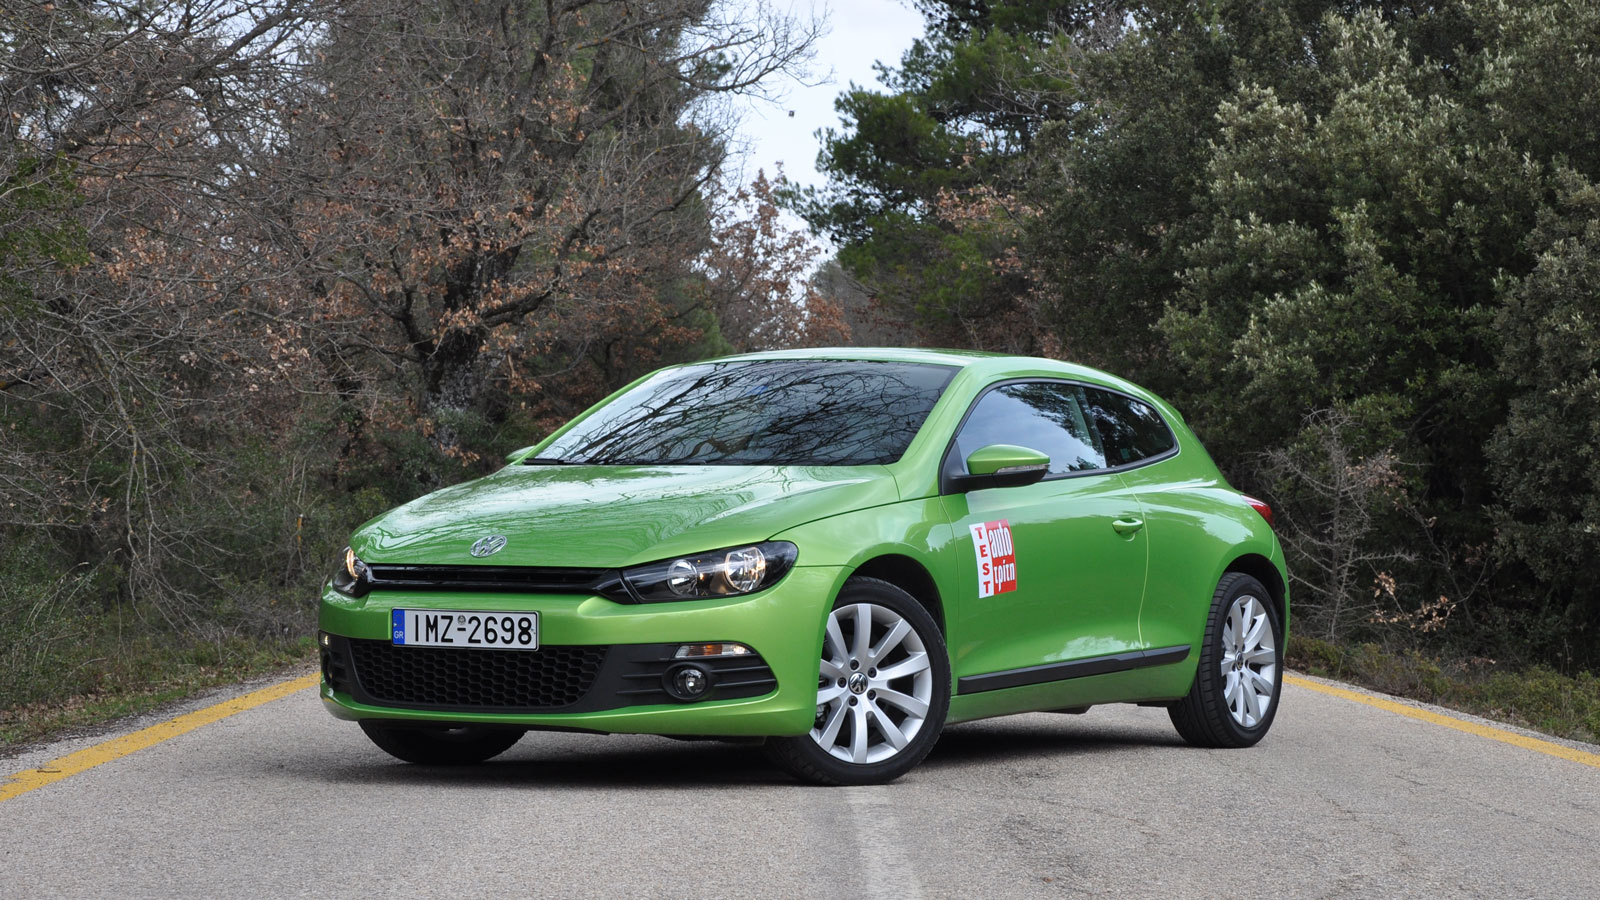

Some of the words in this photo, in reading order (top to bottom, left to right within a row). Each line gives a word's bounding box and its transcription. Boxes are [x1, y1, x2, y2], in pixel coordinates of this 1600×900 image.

[988, 522, 1013, 558] auto
[975, 527, 991, 594] TEST
[393, 630, 404, 639] GR
